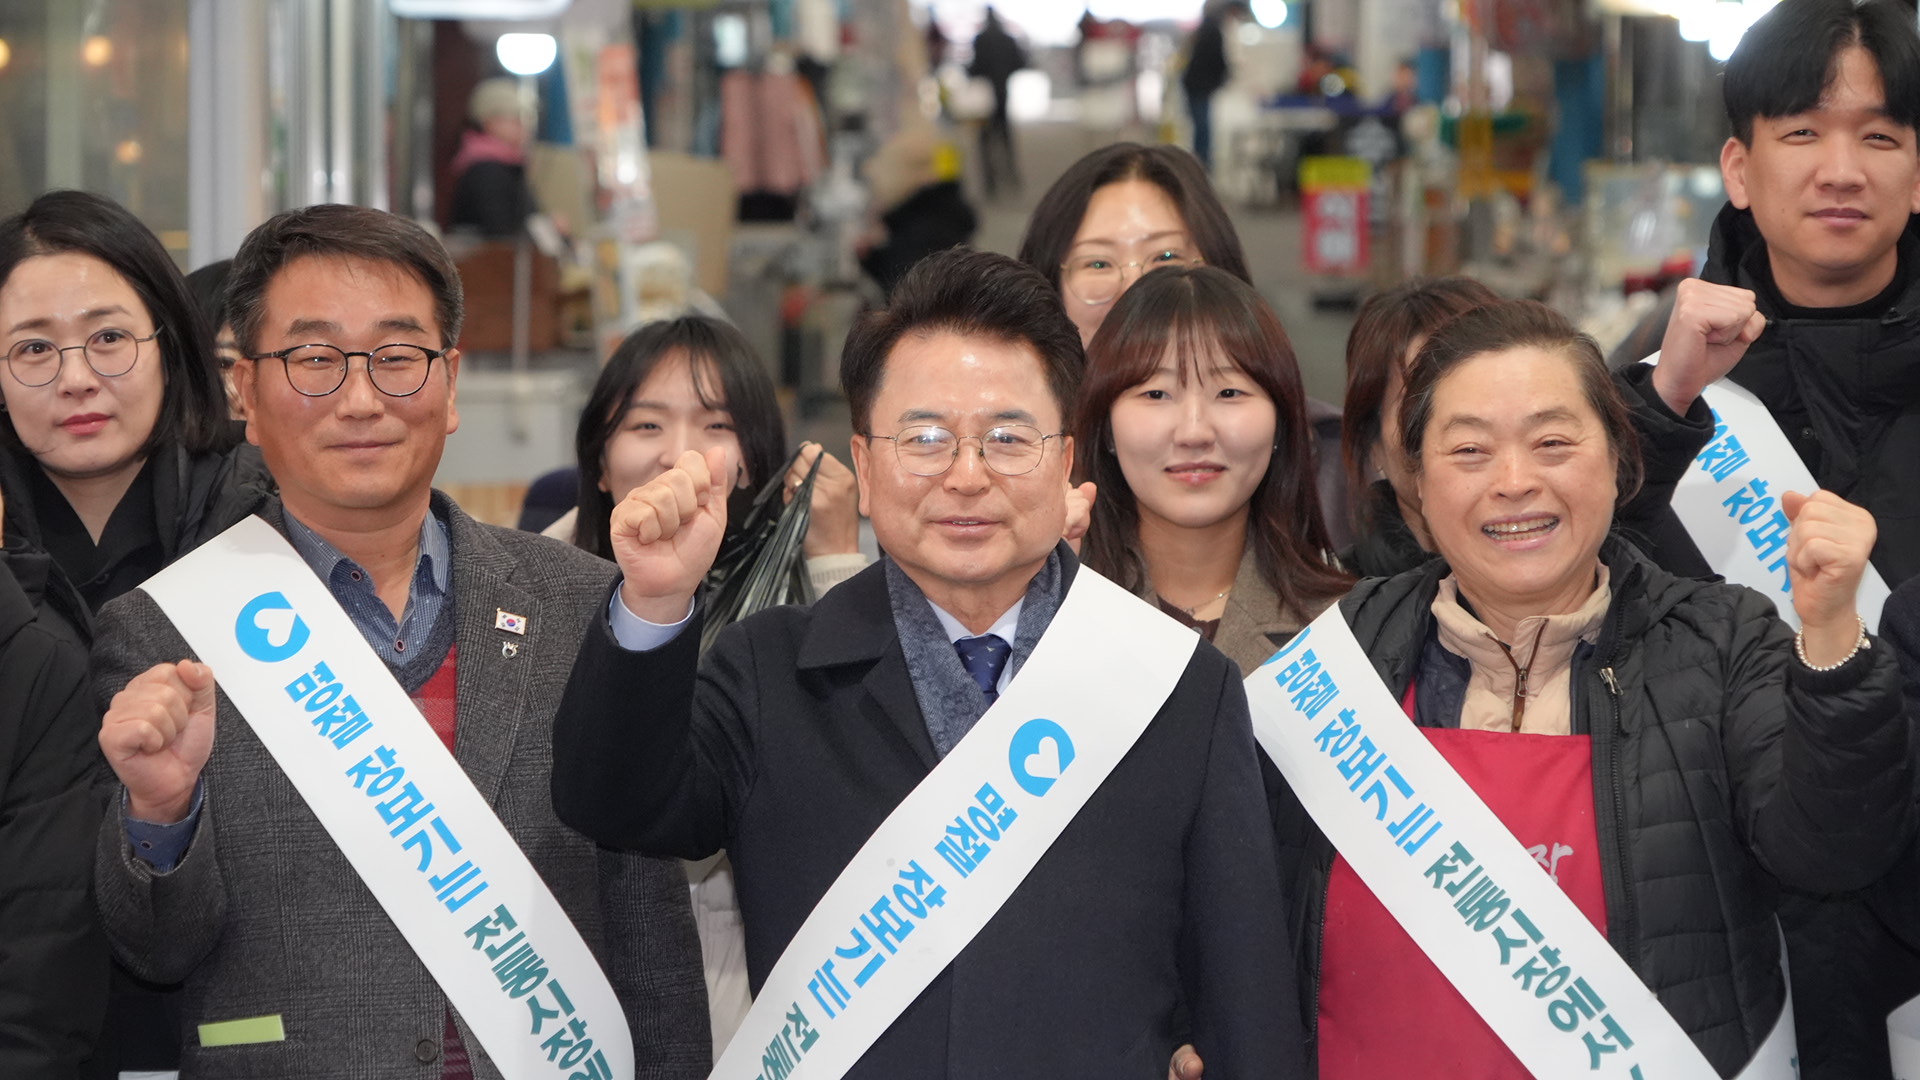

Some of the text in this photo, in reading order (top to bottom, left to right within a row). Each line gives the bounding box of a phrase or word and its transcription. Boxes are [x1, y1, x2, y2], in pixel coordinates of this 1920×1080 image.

[285, 660, 374, 749] 명절
[346, 745, 489, 913] 장보기는
[935, 781, 1018, 879] 명절
[1276, 649, 1632, 1068] 명절 장보기는 전통시장에서
[808, 859, 947, 1019] 장보기는
